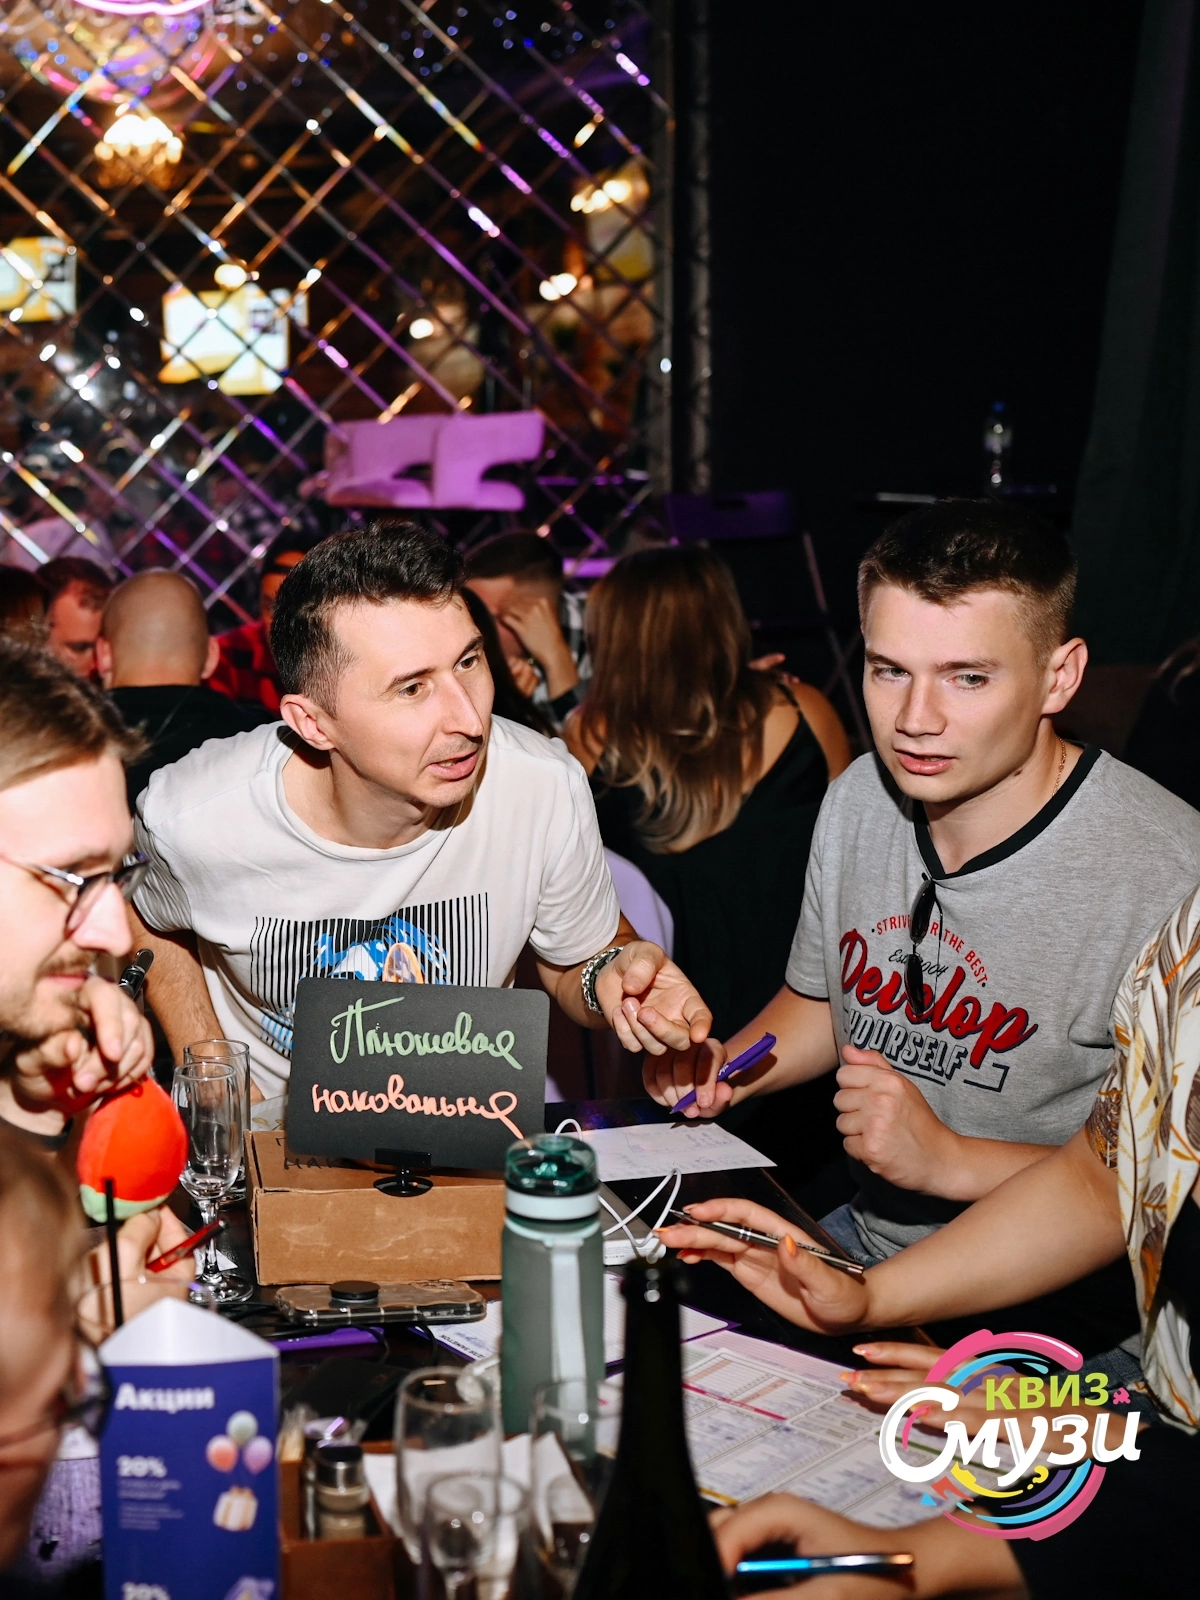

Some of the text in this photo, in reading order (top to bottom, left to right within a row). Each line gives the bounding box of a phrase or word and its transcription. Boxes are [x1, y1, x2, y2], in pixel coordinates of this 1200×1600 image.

[943, 928, 965, 953] THE
[964, 950, 988, 984] BEST
[330, 996, 523, 1070] Плюшевая
[839, 928, 1038, 1070] Develop
[849, 1008, 968, 1080] YOURSELF
[312, 1073, 525, 1140] наковальня
[114, 1382, 215, 1414] Акции
